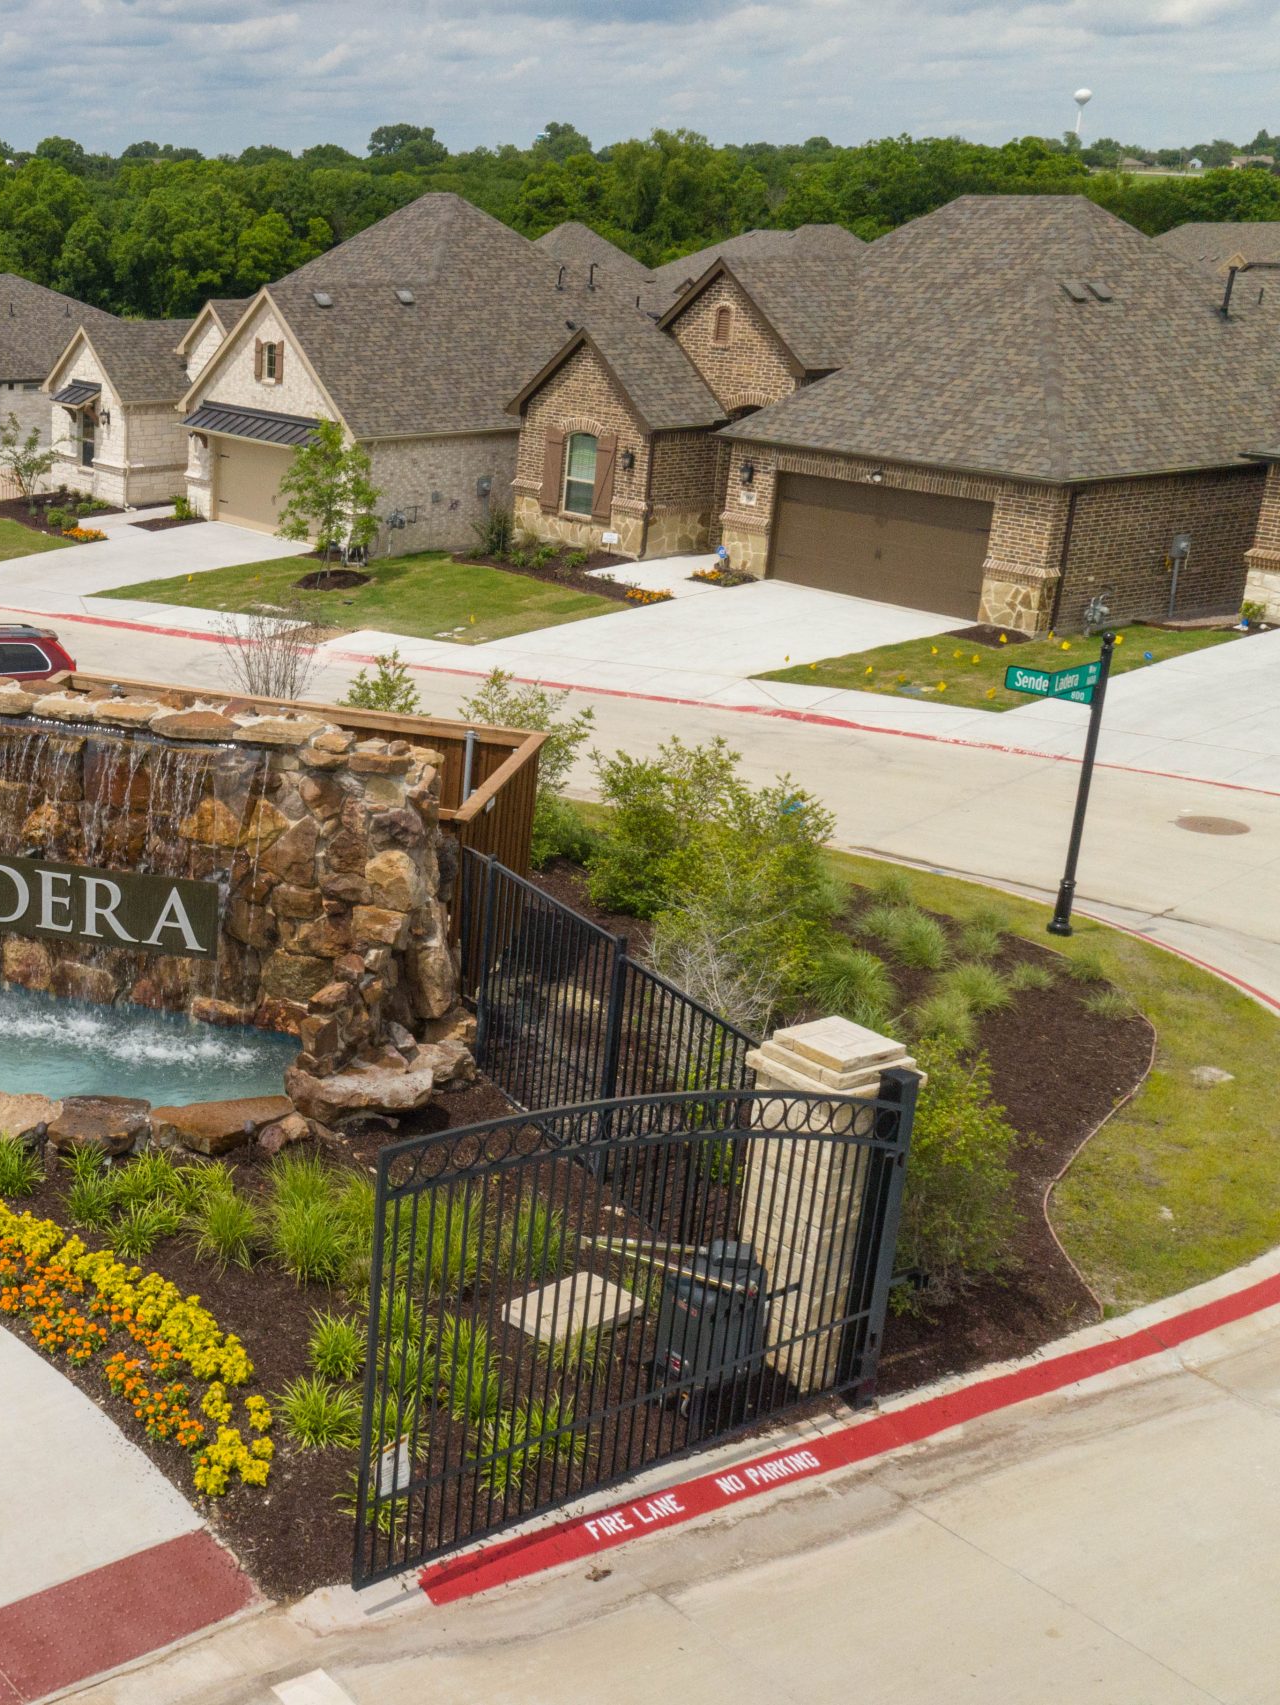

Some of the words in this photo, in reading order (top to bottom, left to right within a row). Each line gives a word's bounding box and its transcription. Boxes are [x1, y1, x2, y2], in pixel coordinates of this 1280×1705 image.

[1054, 673, 1079, 692] Ladera
[584, 1511, 634, 1541] FIRE
[632, 1494, 686, 1524] LANE
[715, 1475, 746, 1496] NO
[744, 1450, 821, 1486] PARKING
